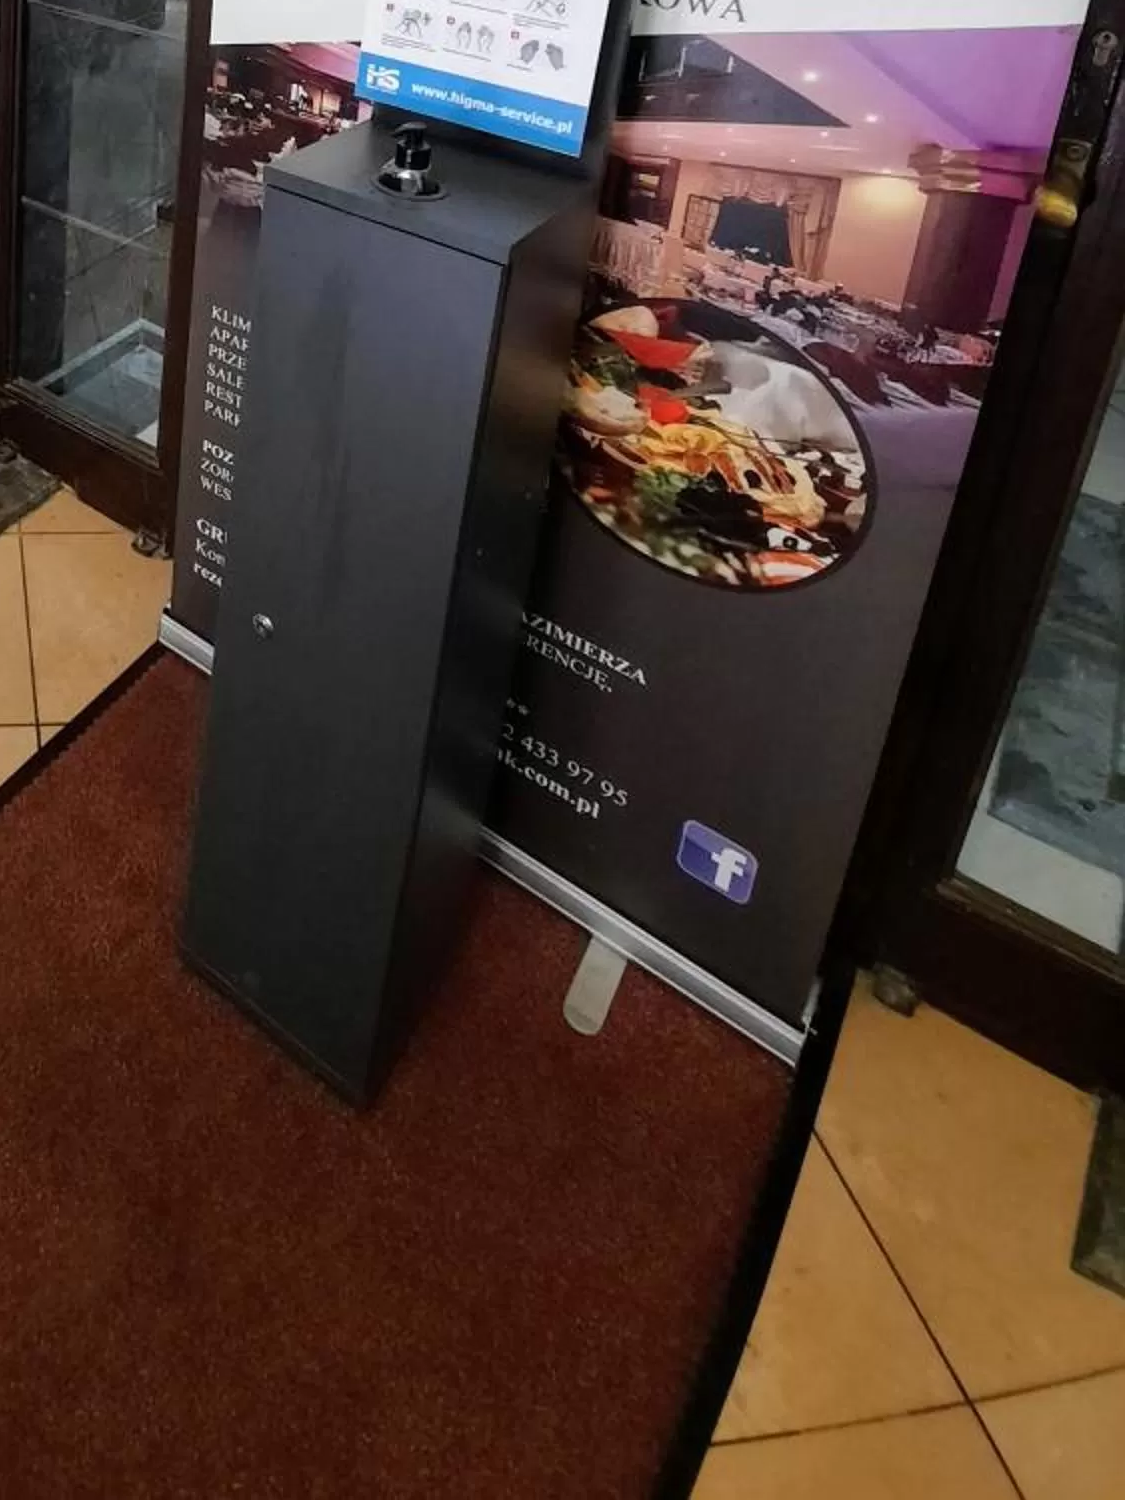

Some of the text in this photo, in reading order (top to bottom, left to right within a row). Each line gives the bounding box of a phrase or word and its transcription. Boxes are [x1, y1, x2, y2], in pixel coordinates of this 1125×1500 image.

[520, 735, 559, 768] 433
[567, 759, 594, 786] 97
[599, 779, 629, 807] 95
